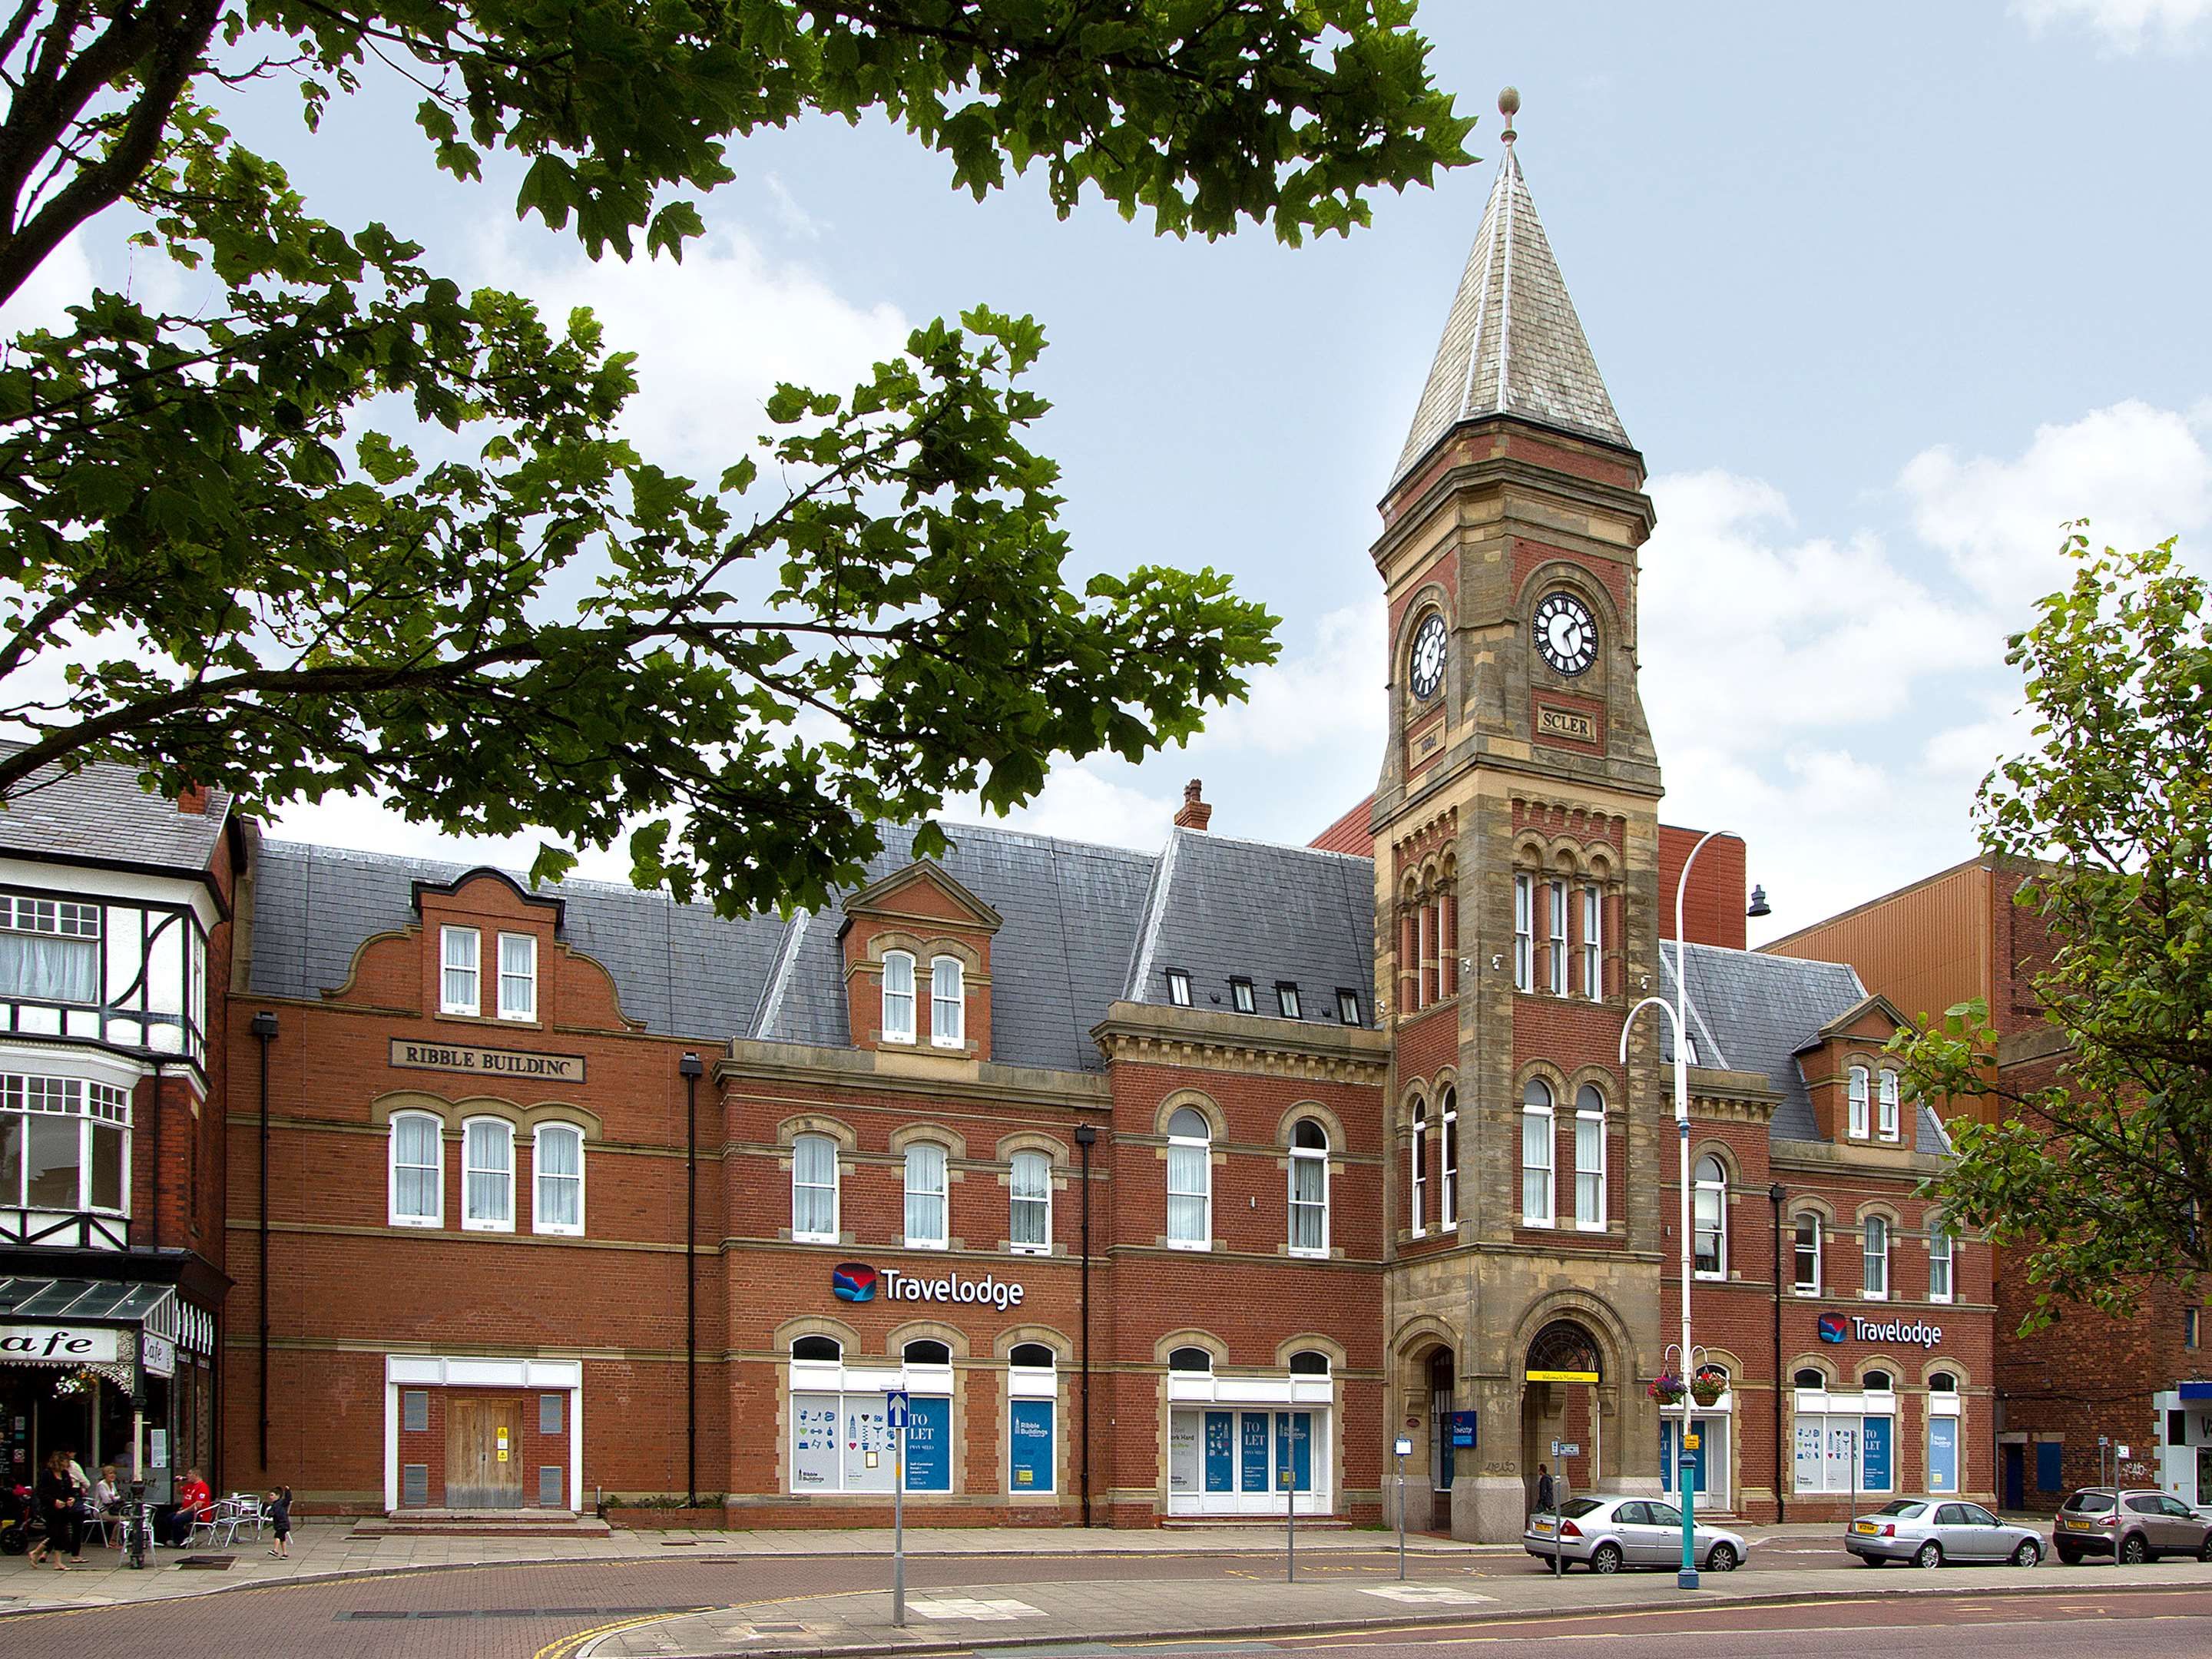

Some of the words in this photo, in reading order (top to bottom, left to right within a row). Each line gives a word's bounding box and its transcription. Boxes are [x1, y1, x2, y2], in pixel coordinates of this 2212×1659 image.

[1543, 713, 1588, 734] SCLER
[406, 1046, 475, 1068] RIBBLE
[880, 1269, 1024, 1311] Travelodge
[1852, 1316, 1942, 1349] Travelodge
[0, 1331, 93, 1356] afe
[909, 1413, 928, 1426] TO
[1244, 1422, 1260, 1432] TO
[2201, 1416, 2212, 1439] V
[909, 1428, 935, 1440] LET
[1245, 1435, 1266, 1445] LET
[1865, 1429, 1876, 1439] TO
[1865, 1441, 1880, 1450] LET
